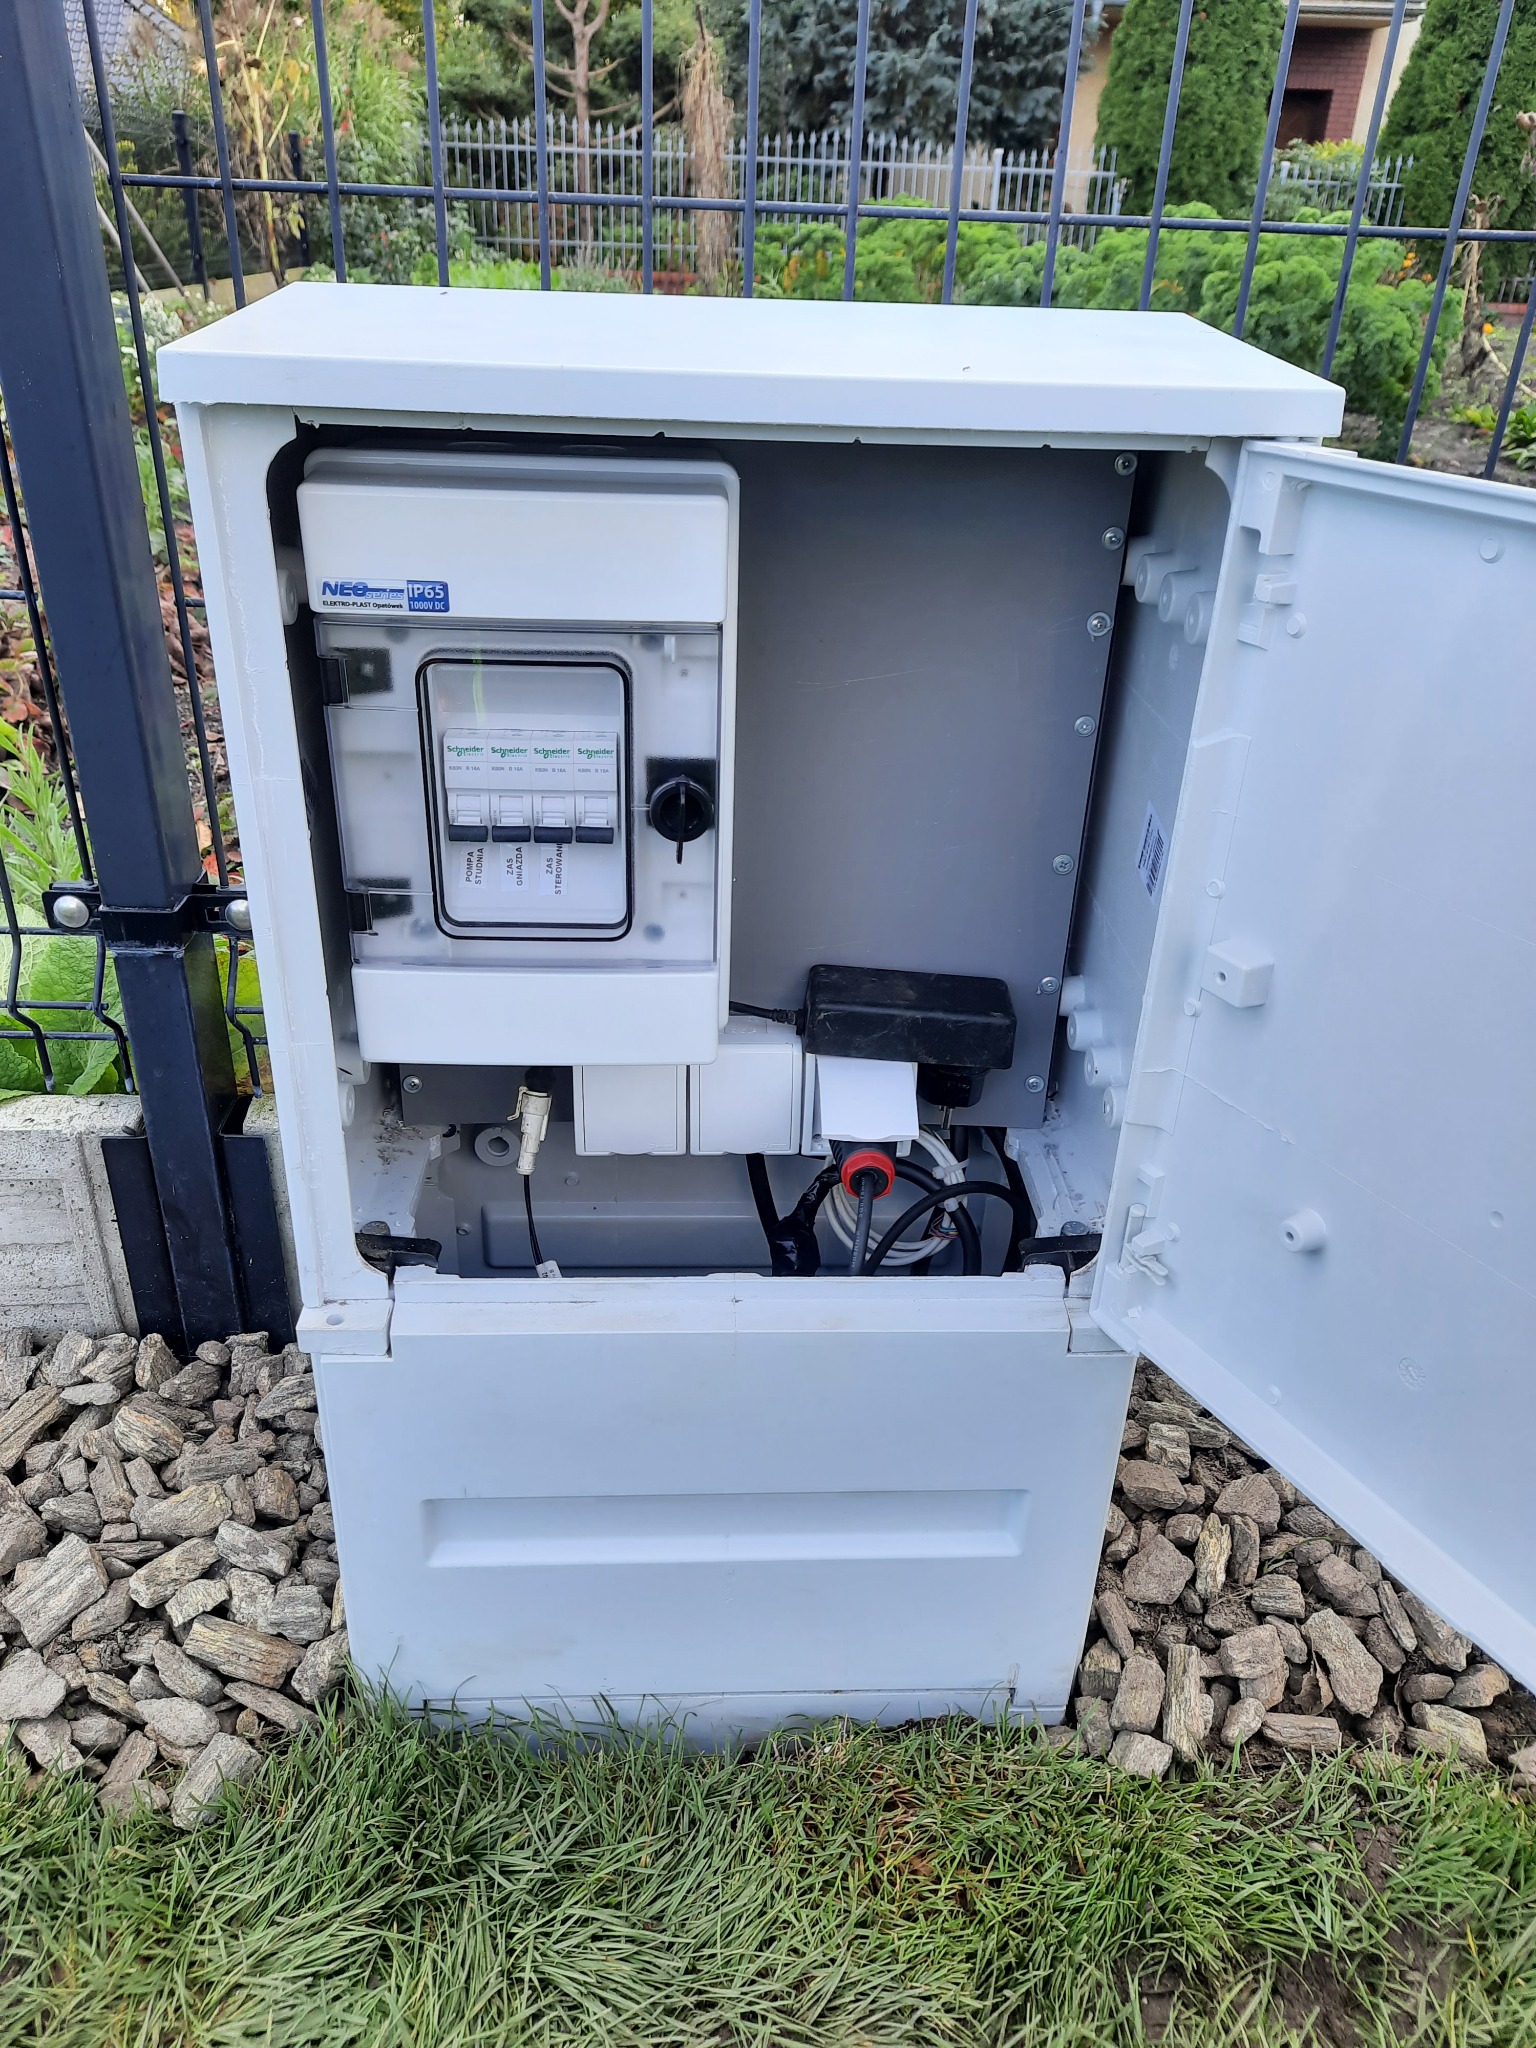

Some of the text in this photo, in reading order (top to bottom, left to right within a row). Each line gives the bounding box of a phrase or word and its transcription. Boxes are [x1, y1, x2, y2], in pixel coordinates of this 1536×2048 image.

[322, 581, 405, 600] NEO series
[409, 584, 445, 599] IP65
[322, 600, 371, 608] ELEKTRO-PLAST
[410, 601, 445, 610] 1000V DC
[447, 745, 484, 757] Schneider
[491, 746, 528, 758] Schneider
[533, 747, 570, 759] Schneider
[577, 748, 614, 759] Schneider
[466, 851, 475, 883] POMPA
[475, 847, 484, 885] STUDNIA
[506, 858, 514, 876] ZAS
[546, 857, 554, 875] ZAS
